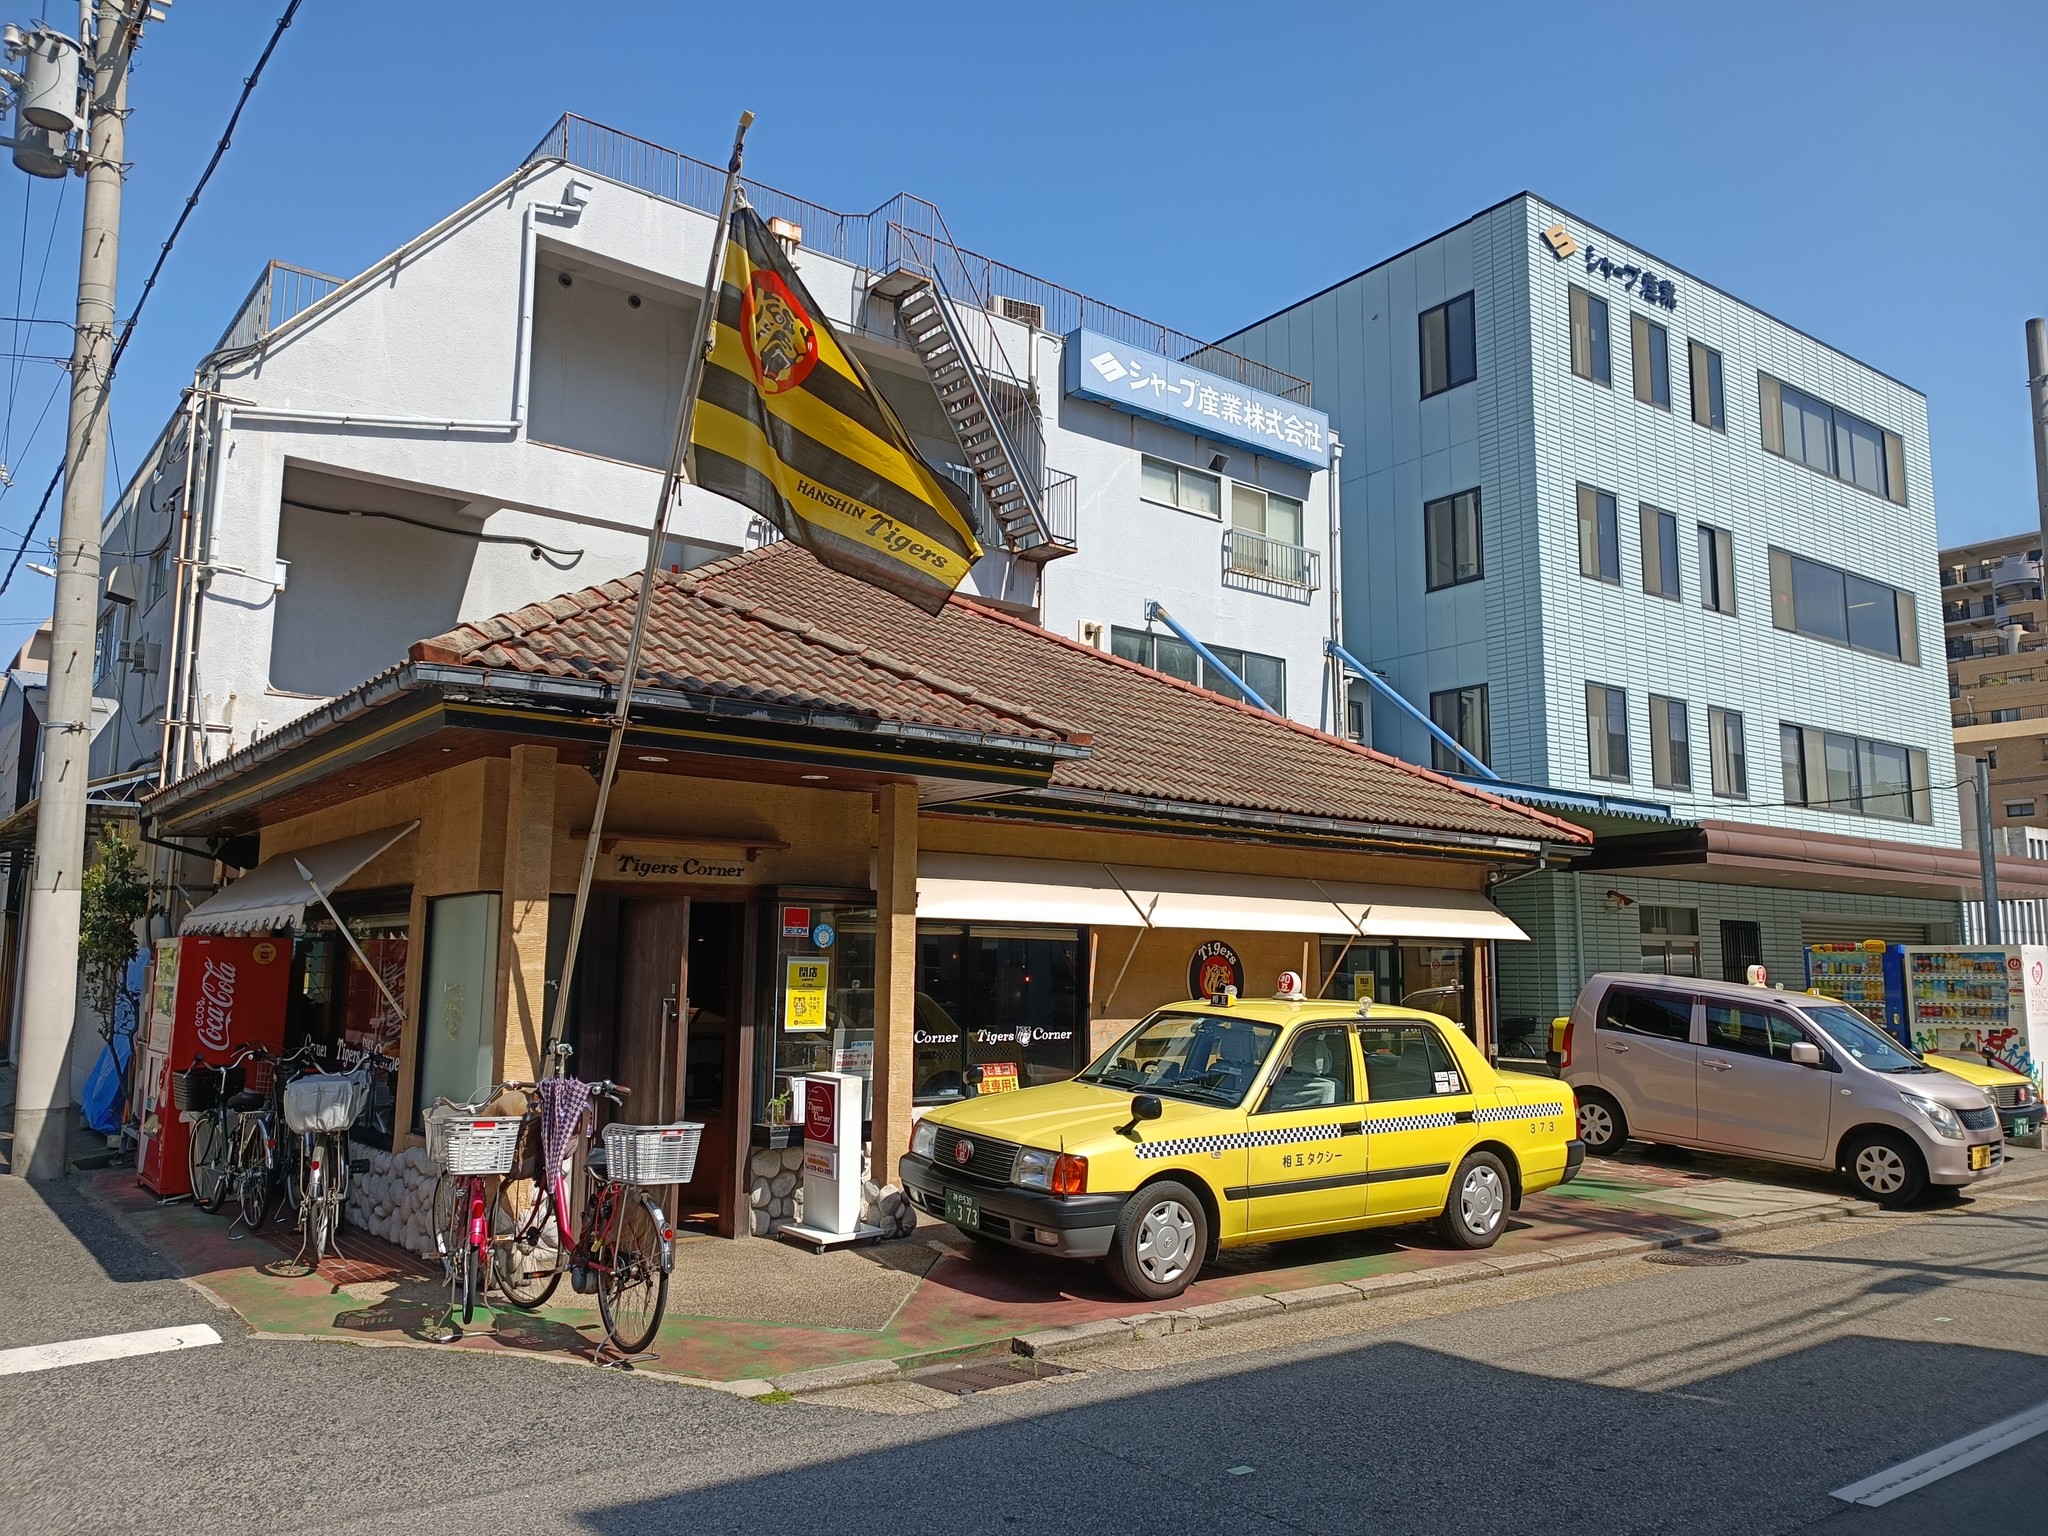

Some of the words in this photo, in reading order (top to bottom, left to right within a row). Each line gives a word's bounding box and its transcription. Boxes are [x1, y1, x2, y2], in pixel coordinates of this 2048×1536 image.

[1129, 360, 1324, 453] シャープ産業株式会社
[797, 480, 867, 519] HANSHIN
[865, 514, 949, 568] Tigers
[618, 855, 678, 877] Tigers
[682, 859, 745, 877] Corner
[1198, 942, 1237, 965] Tigers
[914, 1030, 959, 1044] Corner
[976, 1028, 1015, 1045] Tigers
[1032, 1026, 1073, 1041] Corner
[979, 1078, 1012, 1094] 軽専用
[807, 1101, 824, 1114] Tigers
[813, 1112, 831, 1123] Corner
[1530, 1121, 1556, 1134] 373
[1282, 1151, 1343, 1168] 相互タクシー
